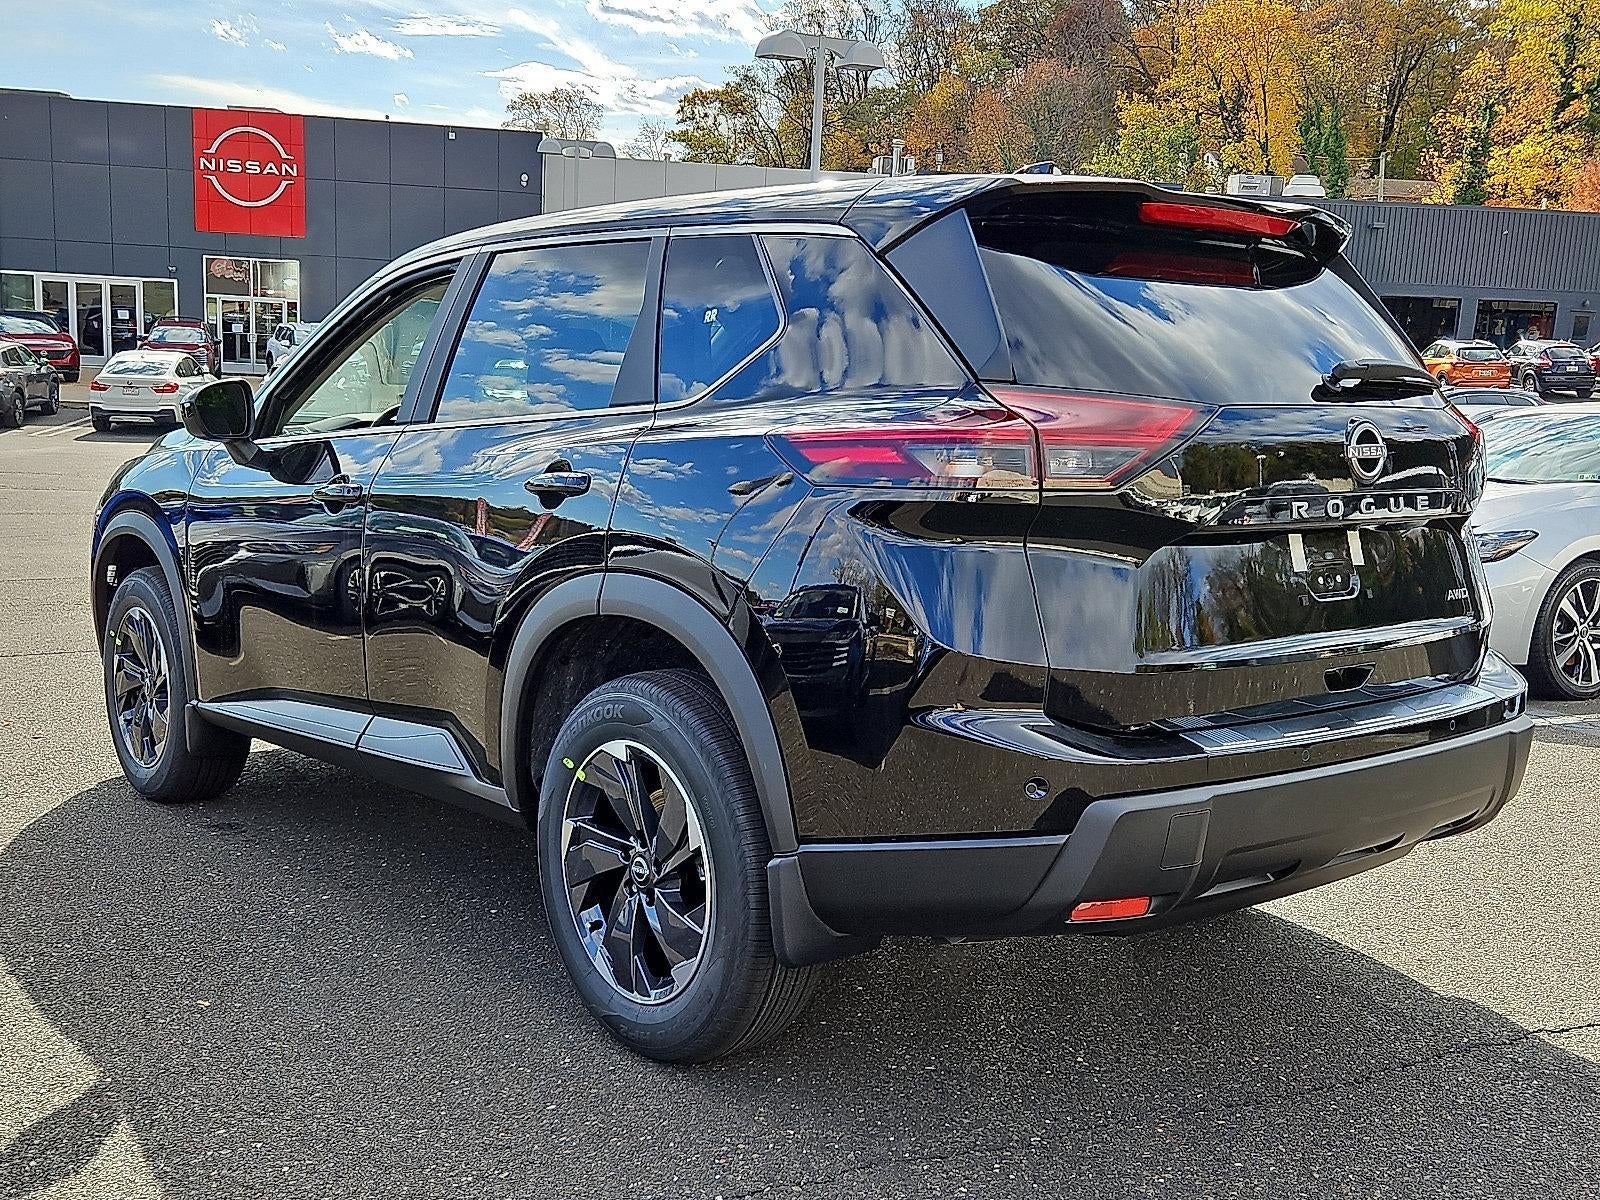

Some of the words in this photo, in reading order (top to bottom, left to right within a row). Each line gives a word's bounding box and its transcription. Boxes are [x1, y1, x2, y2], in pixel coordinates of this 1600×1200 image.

[199, 157, 298, 177] NISSAN
[1348, 446, 1387, 458] NISSAN
[1291, 495, 1430, 520] ROGUE
[1447, 588, 1469, 601] AWD
